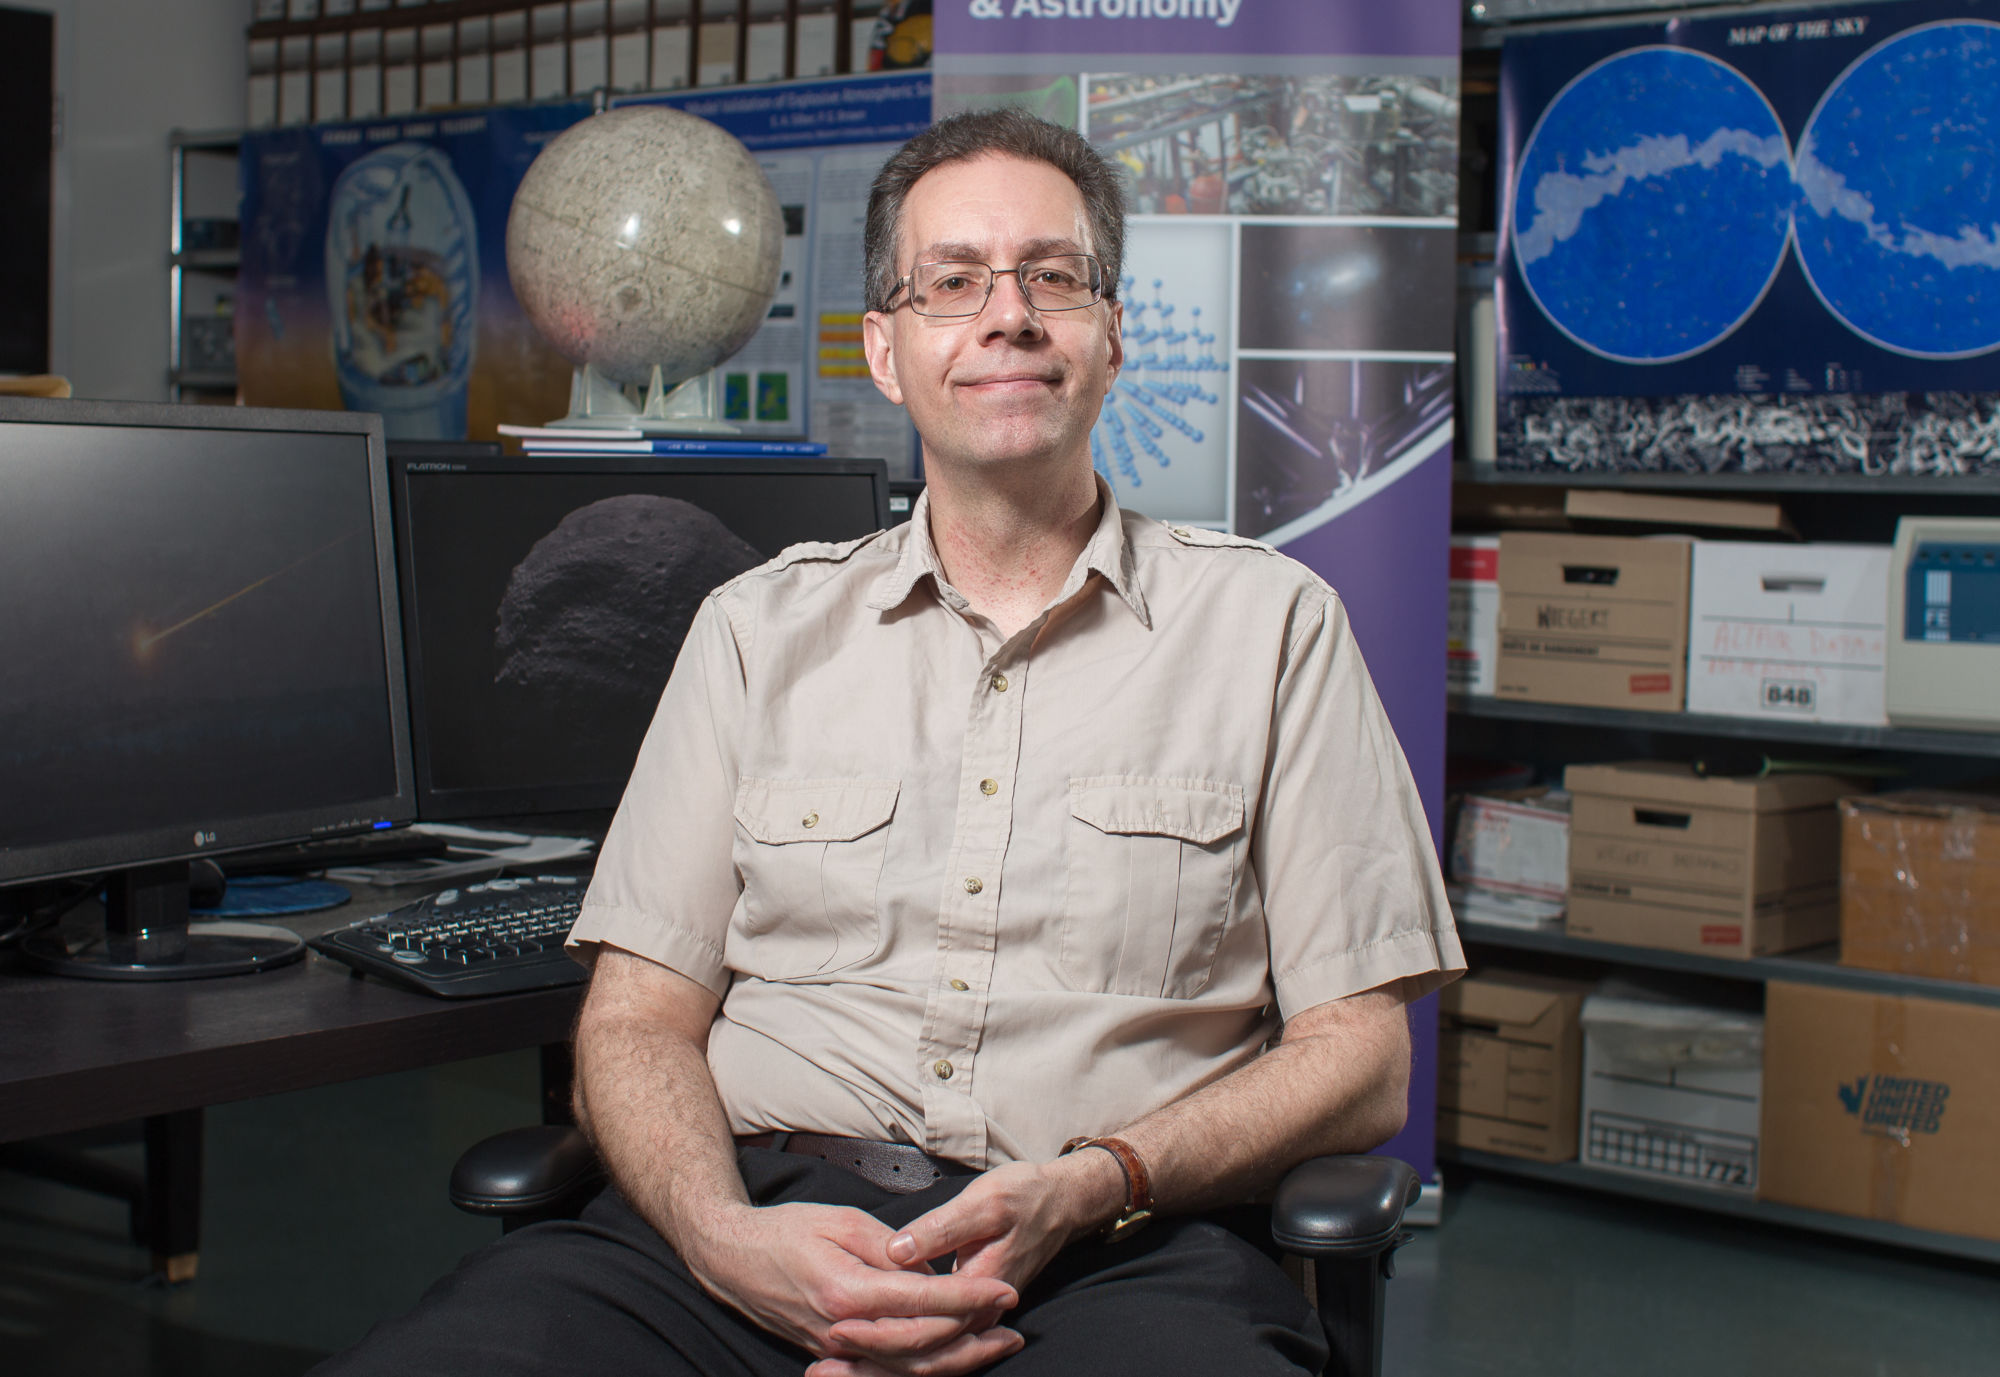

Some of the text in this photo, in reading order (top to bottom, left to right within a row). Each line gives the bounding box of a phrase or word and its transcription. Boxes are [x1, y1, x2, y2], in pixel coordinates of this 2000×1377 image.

[969, 0, 1243, 27] & Astronomy
[1728, 17, 1869, 45] MAP OF THE SKY
[842, 84, 912, 104] Atmospheric
[406, 462, 451, 472] FLATRON
[1767, 685, 1812, 706] 848
[205, 831, 217, 843] LG
[1874, 1075, 1951, 1101] UNITED
[1869, 1092, 1946, 1117] UNITED
[1863, 1108, 1940, 1135] UNITED
[1705, 1159, 1747, 1185] 772
